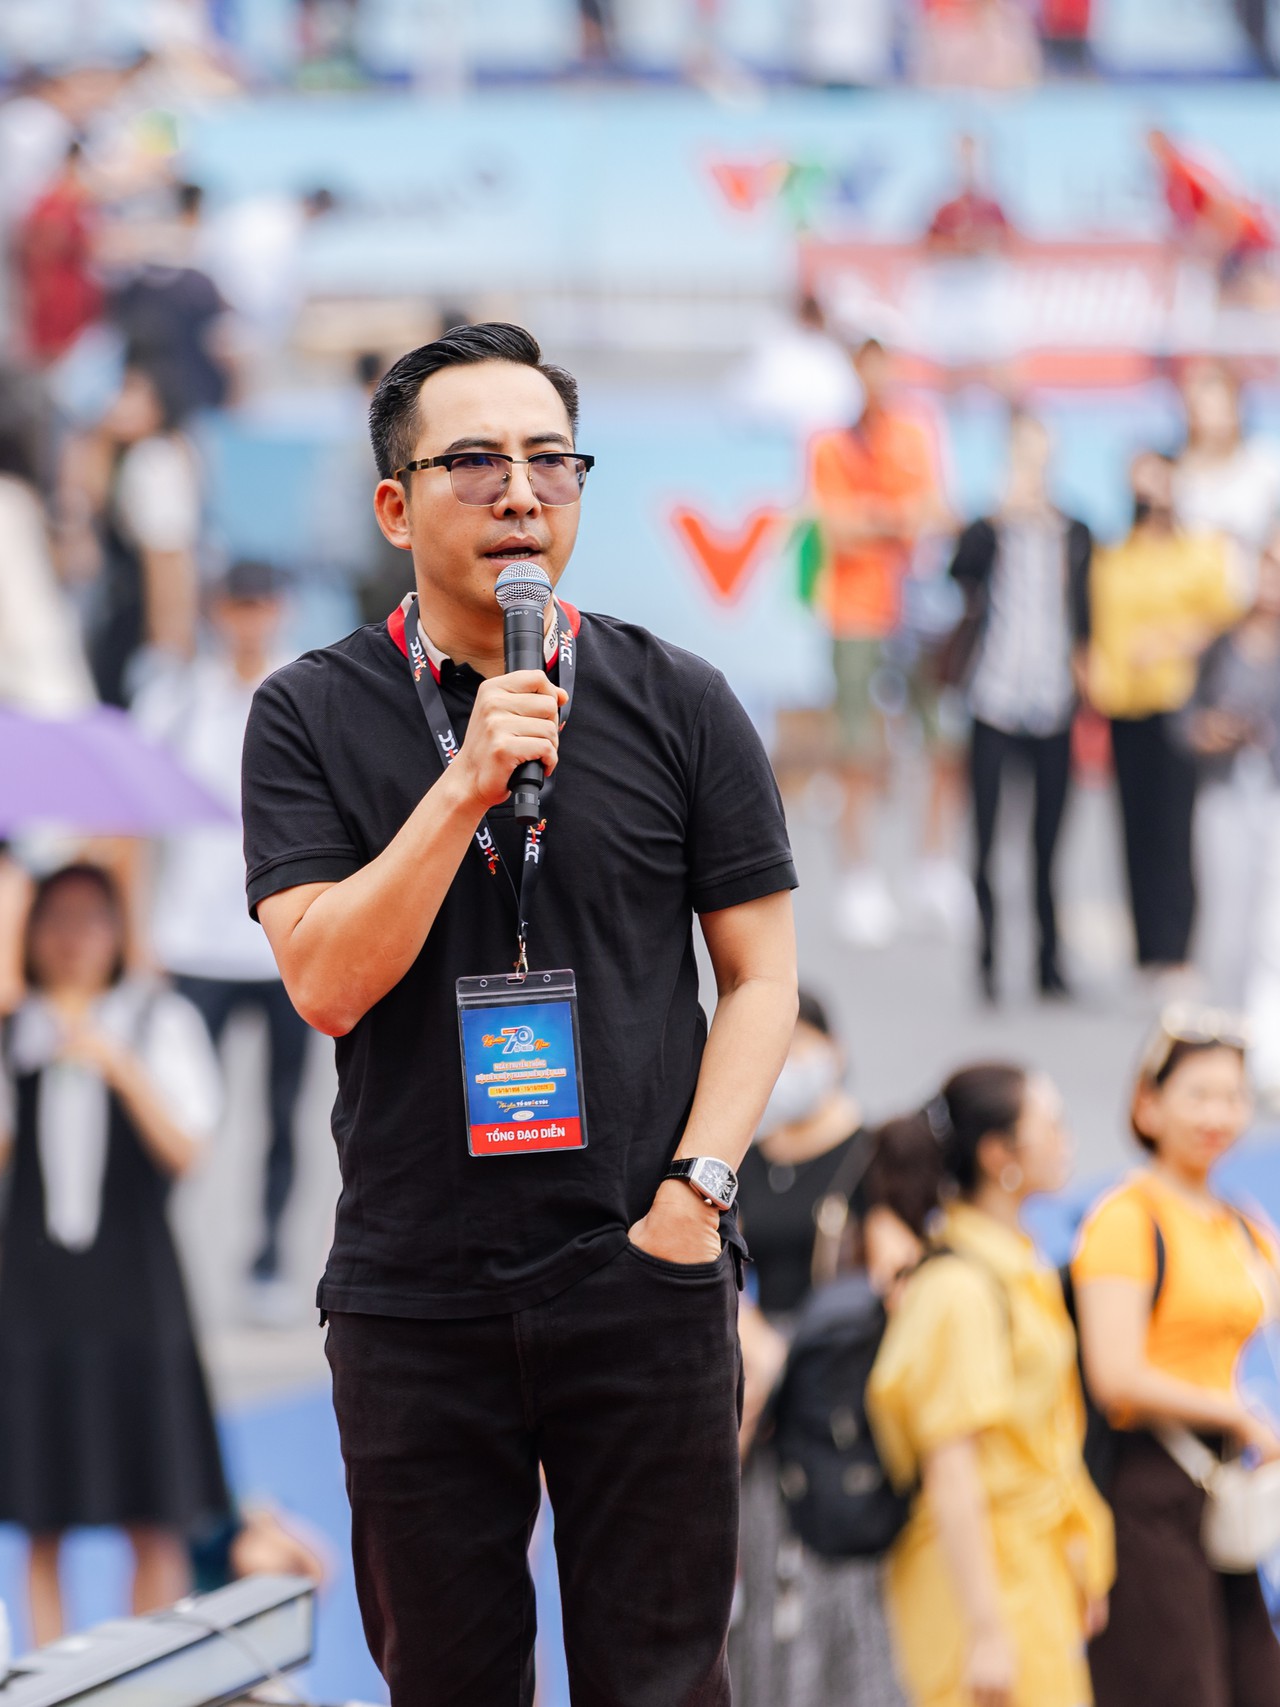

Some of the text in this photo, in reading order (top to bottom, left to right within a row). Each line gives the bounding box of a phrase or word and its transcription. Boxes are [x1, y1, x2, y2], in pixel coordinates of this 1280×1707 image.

[486, 1123, 565, 1142] TỔNG ĐẠO DIỄN
